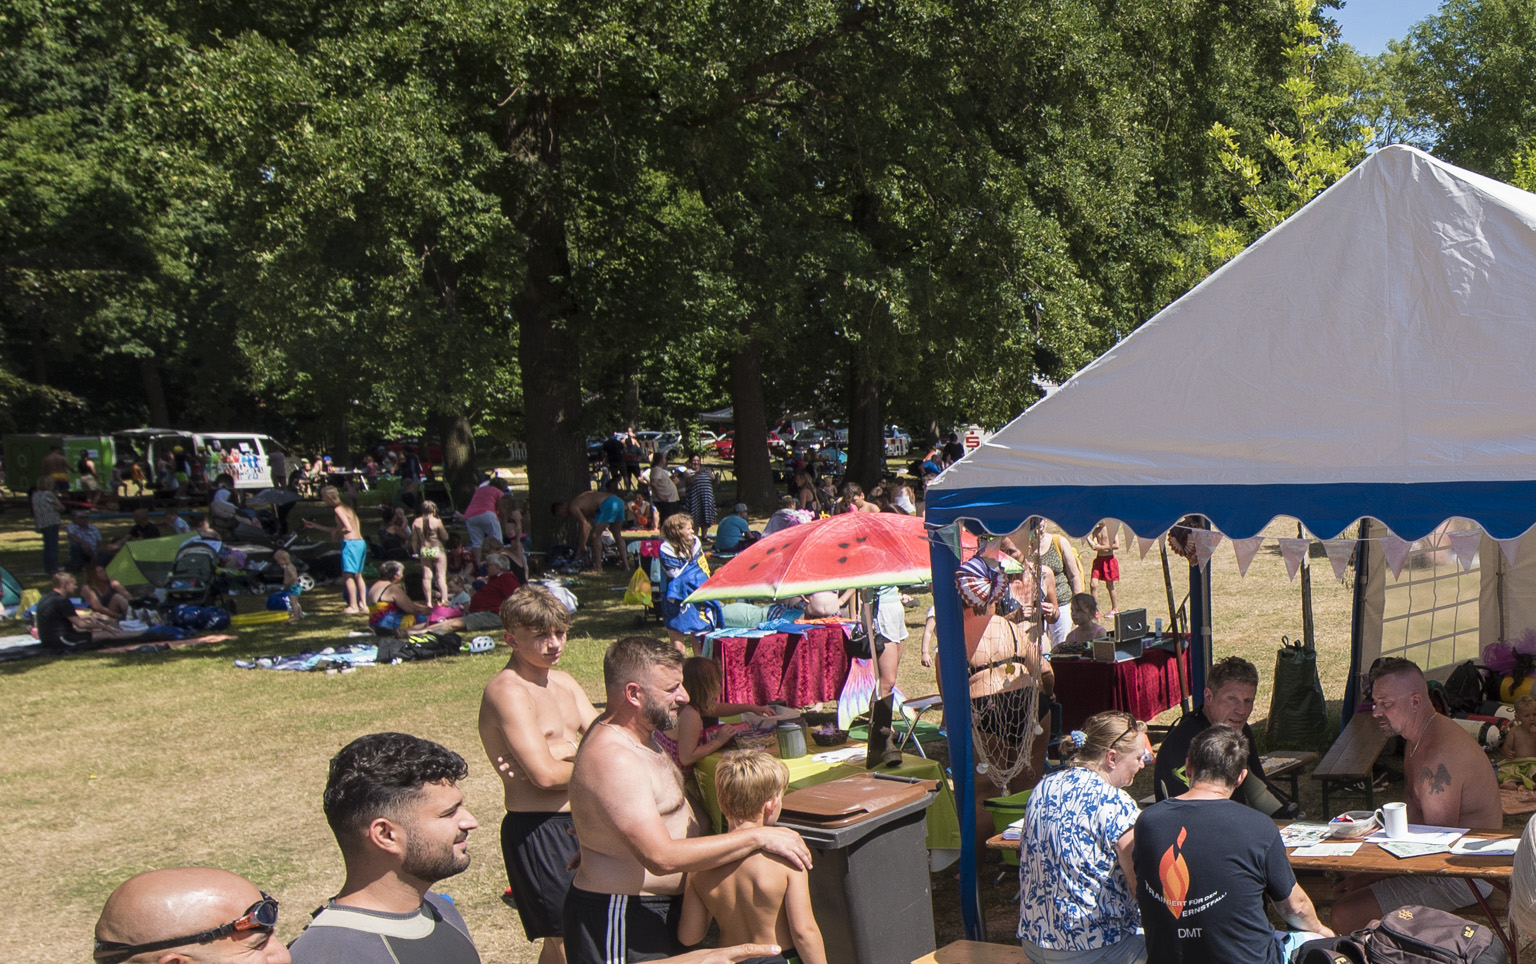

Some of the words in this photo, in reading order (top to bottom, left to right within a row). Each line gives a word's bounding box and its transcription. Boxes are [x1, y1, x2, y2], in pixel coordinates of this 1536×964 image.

[1145, 879, 1188, 907] TRAINIERT
[1188, 898, 1204, 906] FÜR
[1204, 890, 1218, 901] DEN
[1177, 928, 1203, 939] DMT
